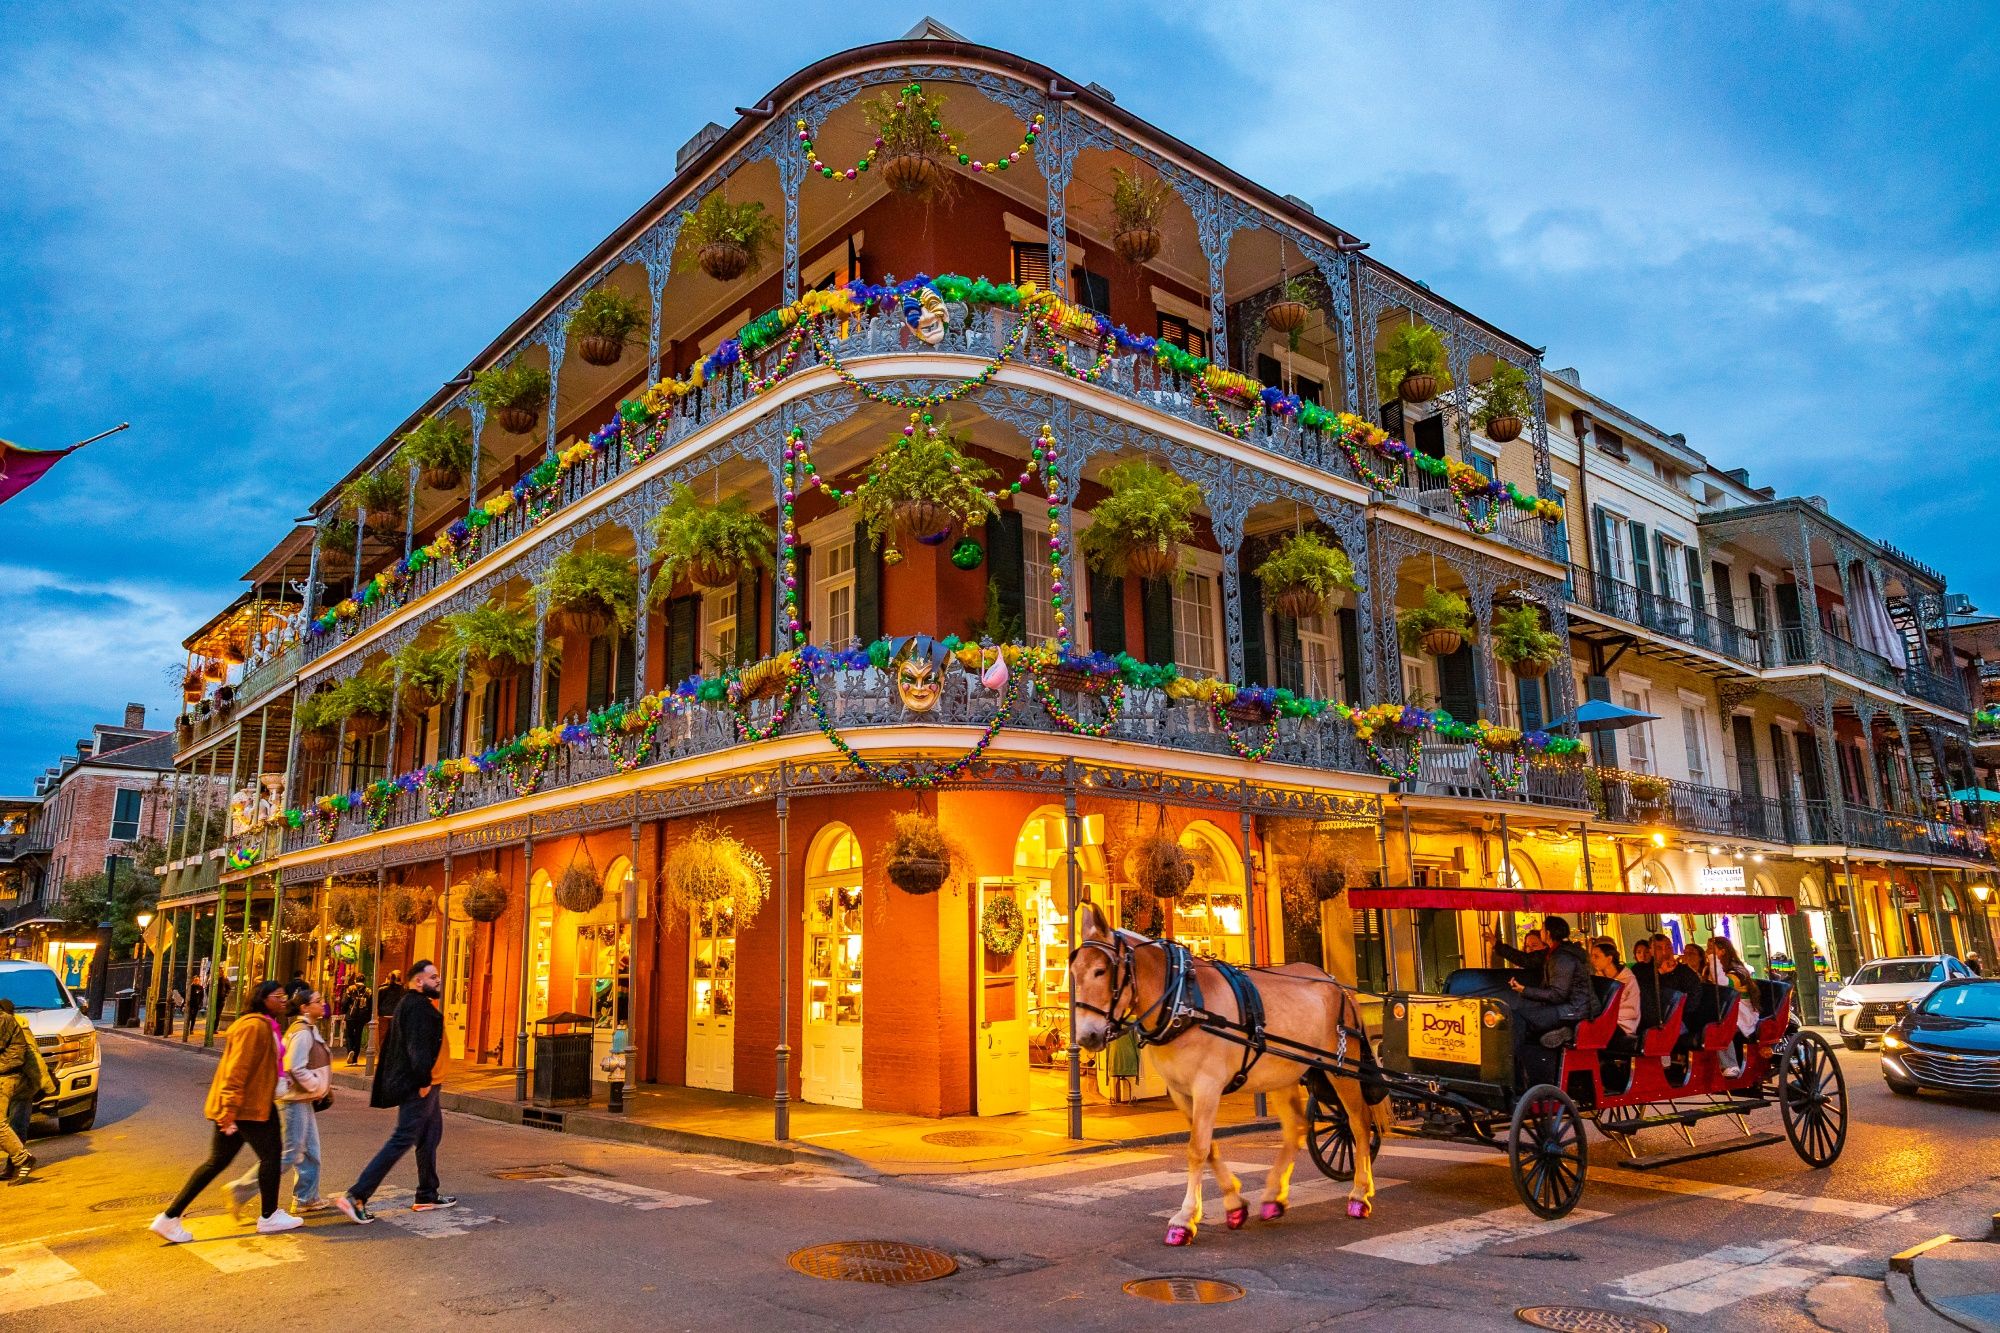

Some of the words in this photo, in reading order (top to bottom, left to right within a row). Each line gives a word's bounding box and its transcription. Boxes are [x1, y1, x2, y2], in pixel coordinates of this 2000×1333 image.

[1703, 868, 1742, 876] Discount
[1422, 1013, 1465, 1036] Royal
[1422, 1033, 1466, 1051] Carriages
